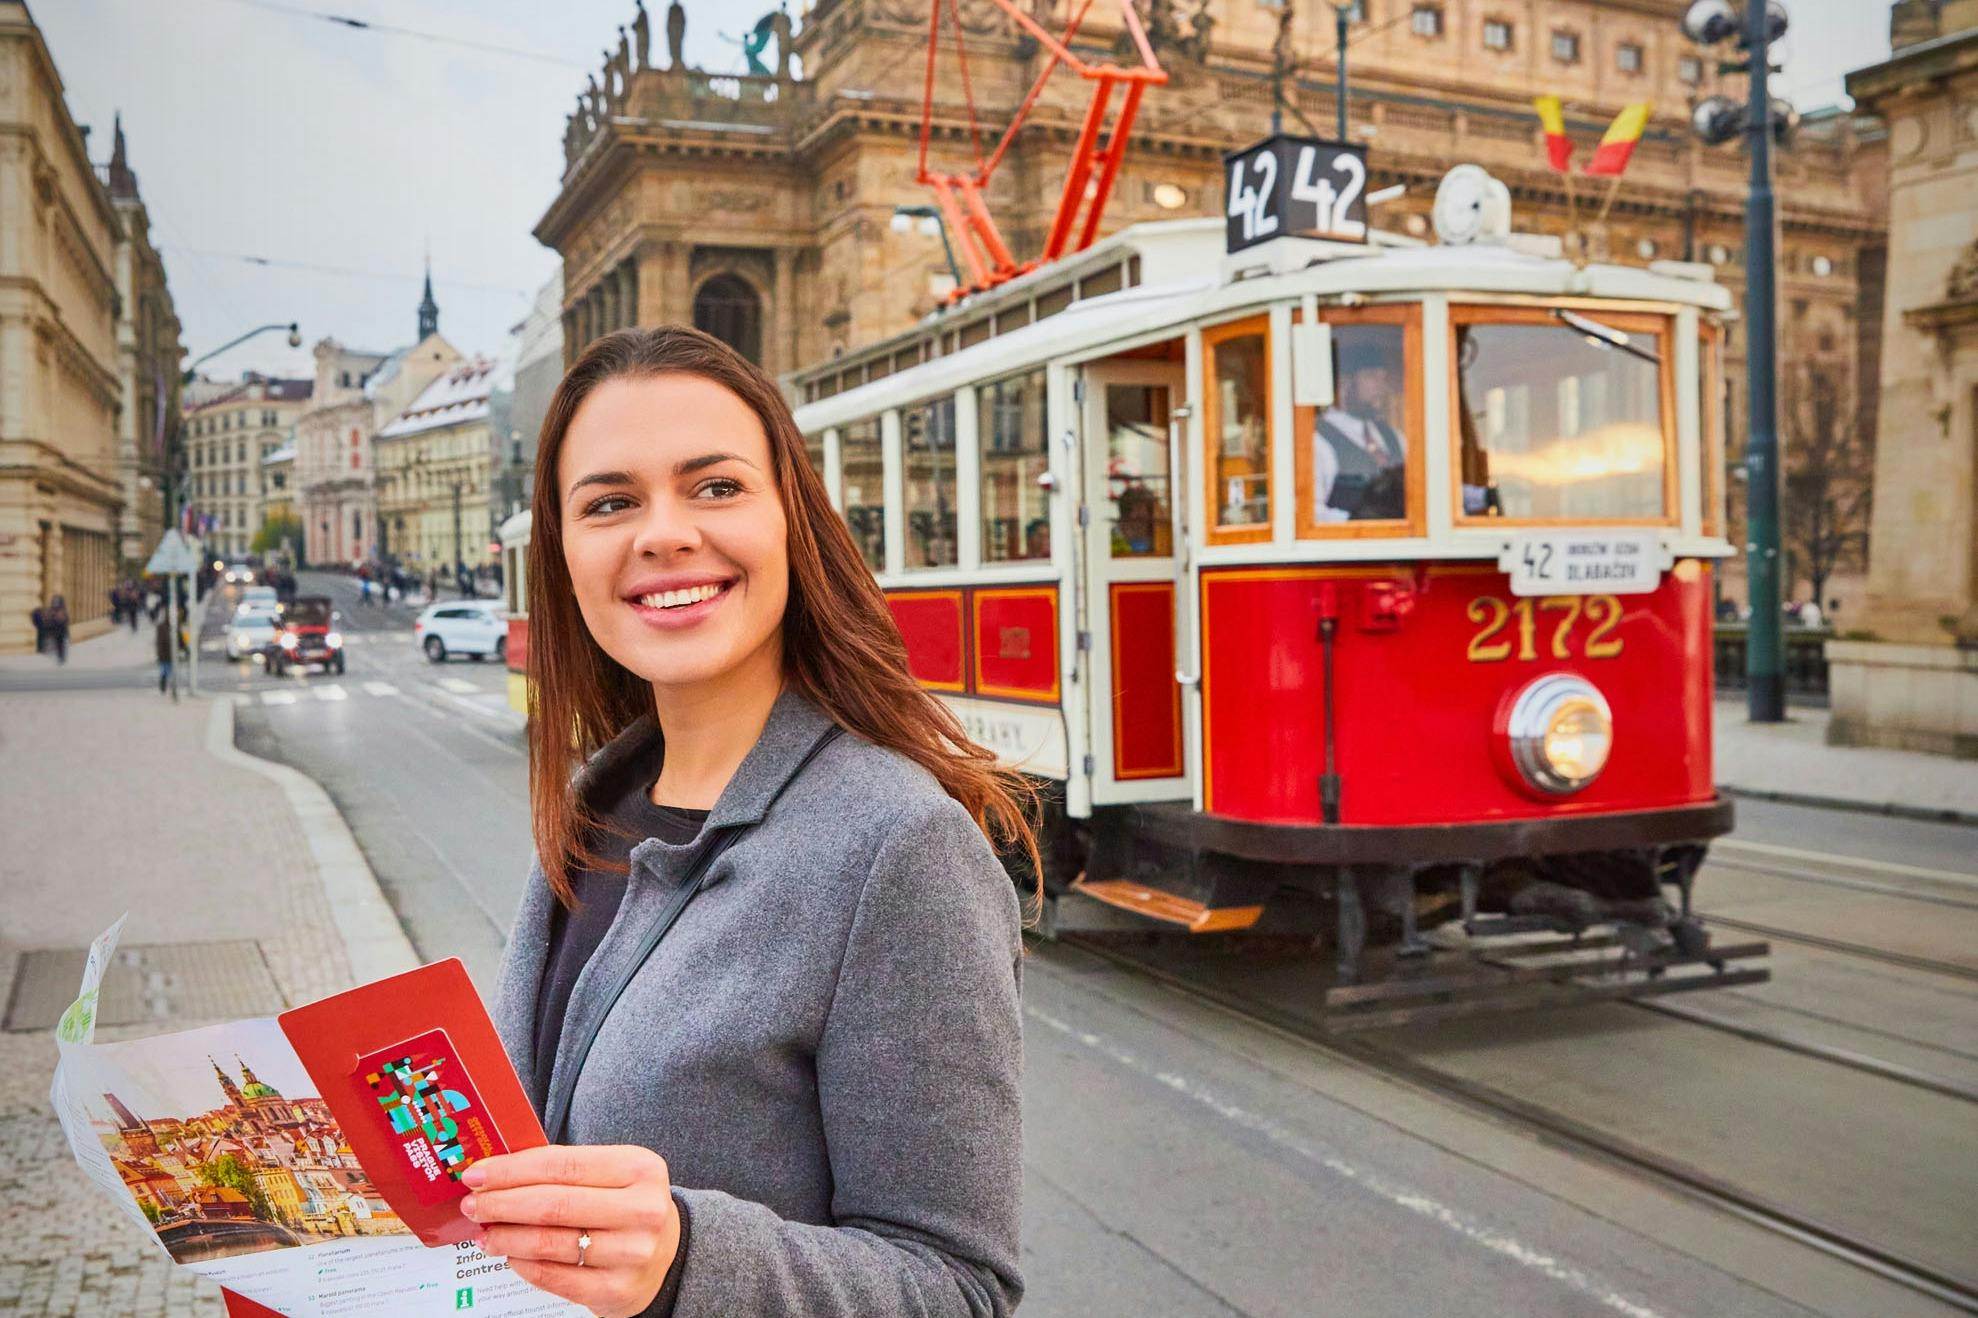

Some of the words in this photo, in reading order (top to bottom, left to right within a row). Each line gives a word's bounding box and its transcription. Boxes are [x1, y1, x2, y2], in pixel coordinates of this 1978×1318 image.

[1228, 150, 1279, 240] 42
[1291, 146, 1366, 236] 42
[1524, 542, 1554, 578] 42
[1467, 594, 1624, 662] 2172
[403, 1142, 421, 1169] PASS
[410, 1139, 436, 1182] VISITOR
[417, 1137, 441, 1177] PRAGUE
[456, 1261, 511, 1279] Centres
